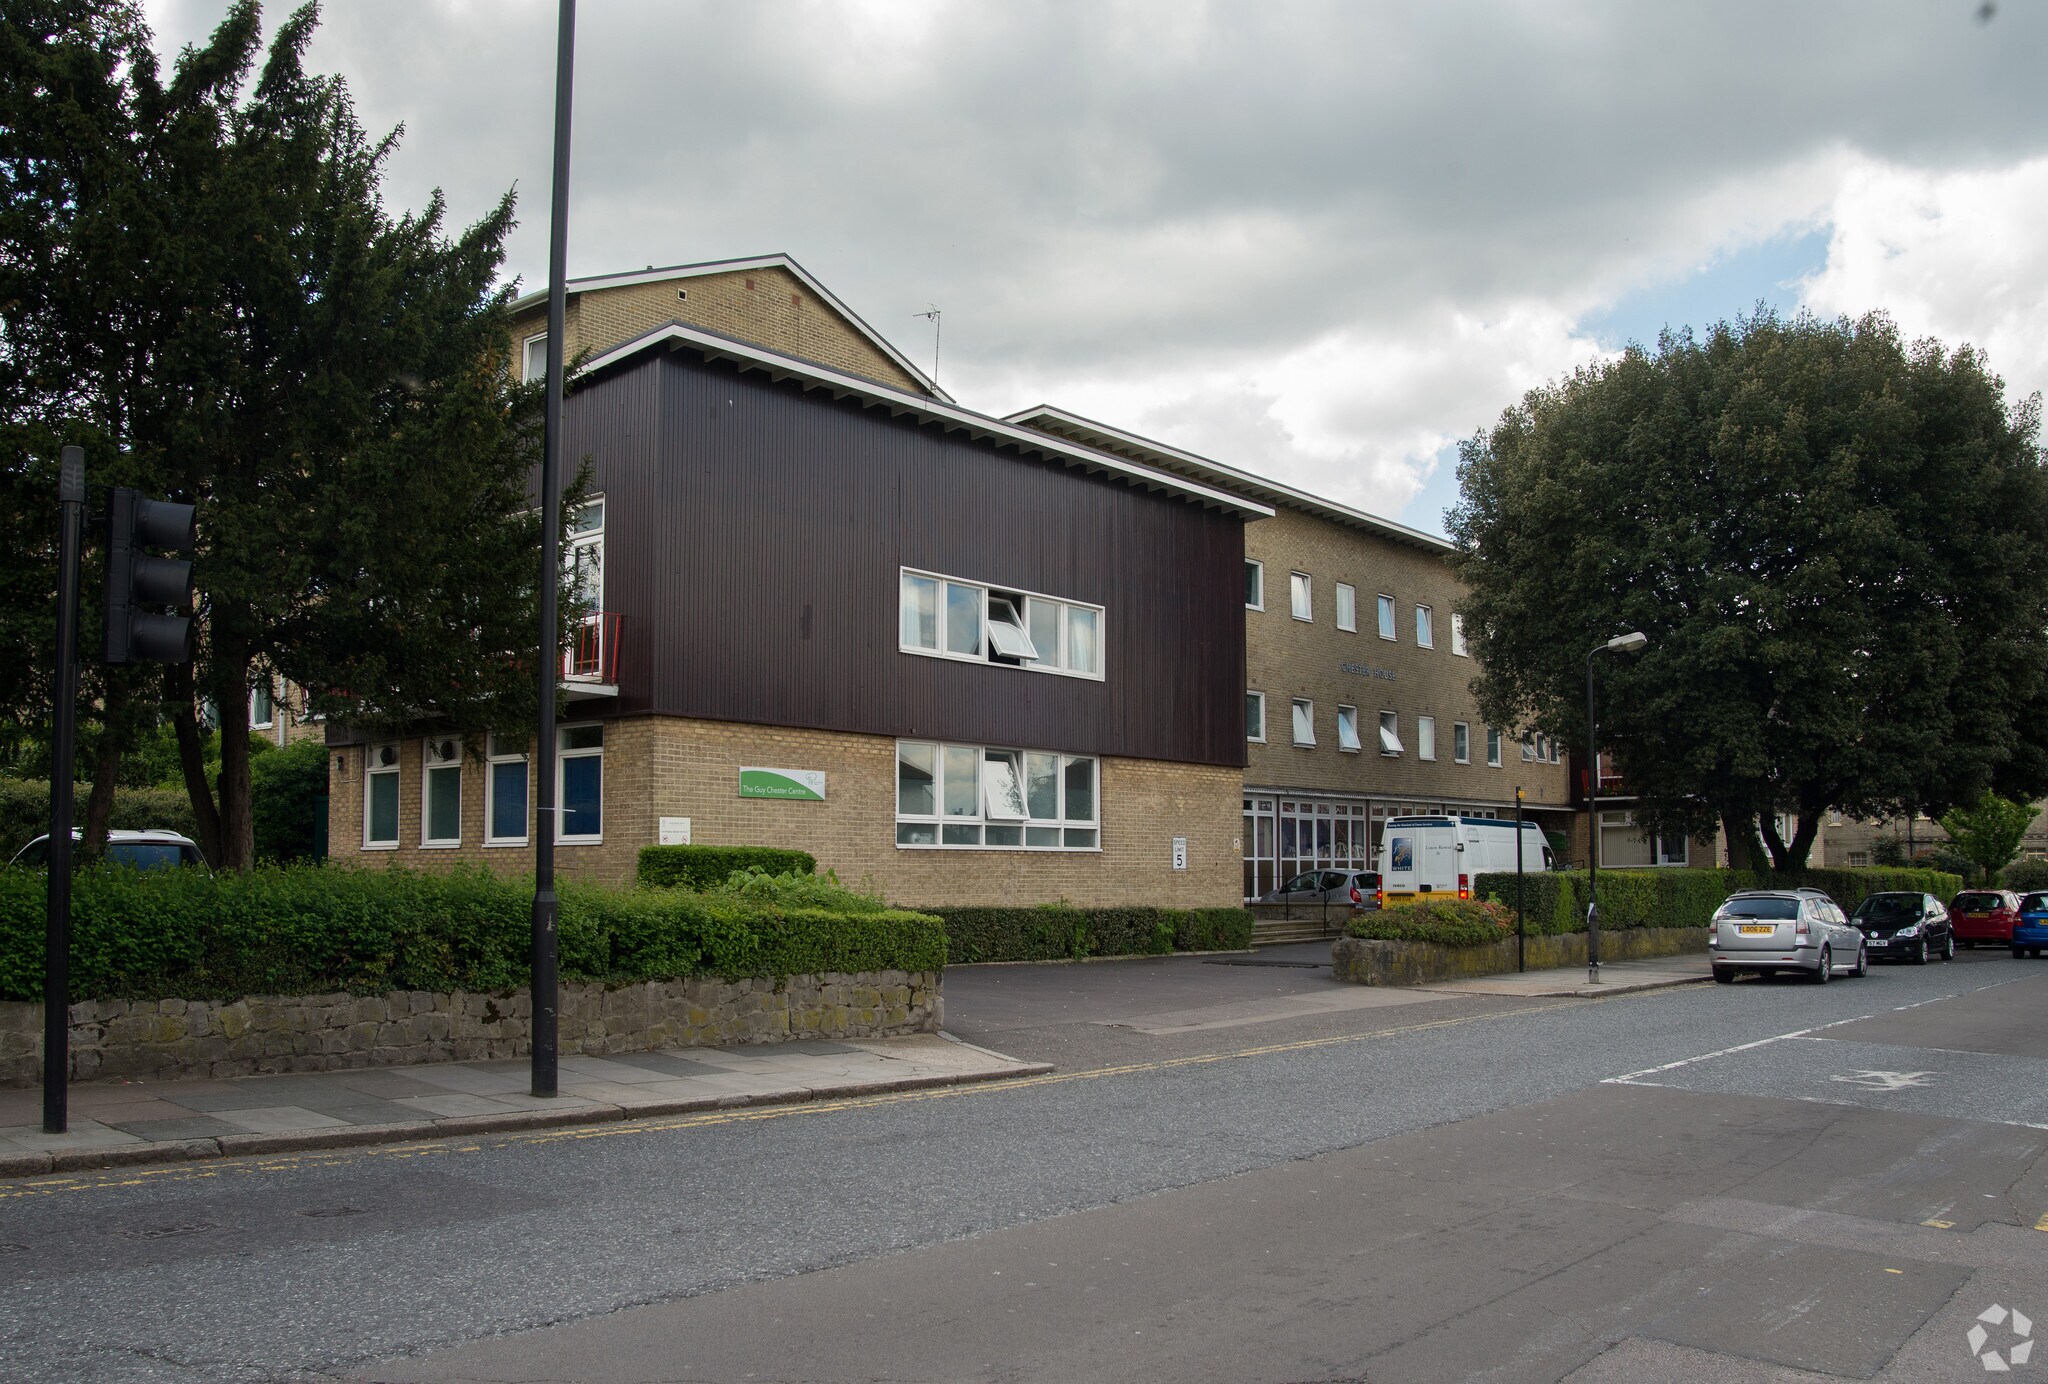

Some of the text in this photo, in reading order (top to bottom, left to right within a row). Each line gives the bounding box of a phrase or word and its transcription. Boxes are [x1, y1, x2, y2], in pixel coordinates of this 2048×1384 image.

[1341, 662, 1396, 681] CHESTER HOUSE
[743, 785, 806, 795] The Guy Chester Centre
[1176, 854, 1183, 866] 5
